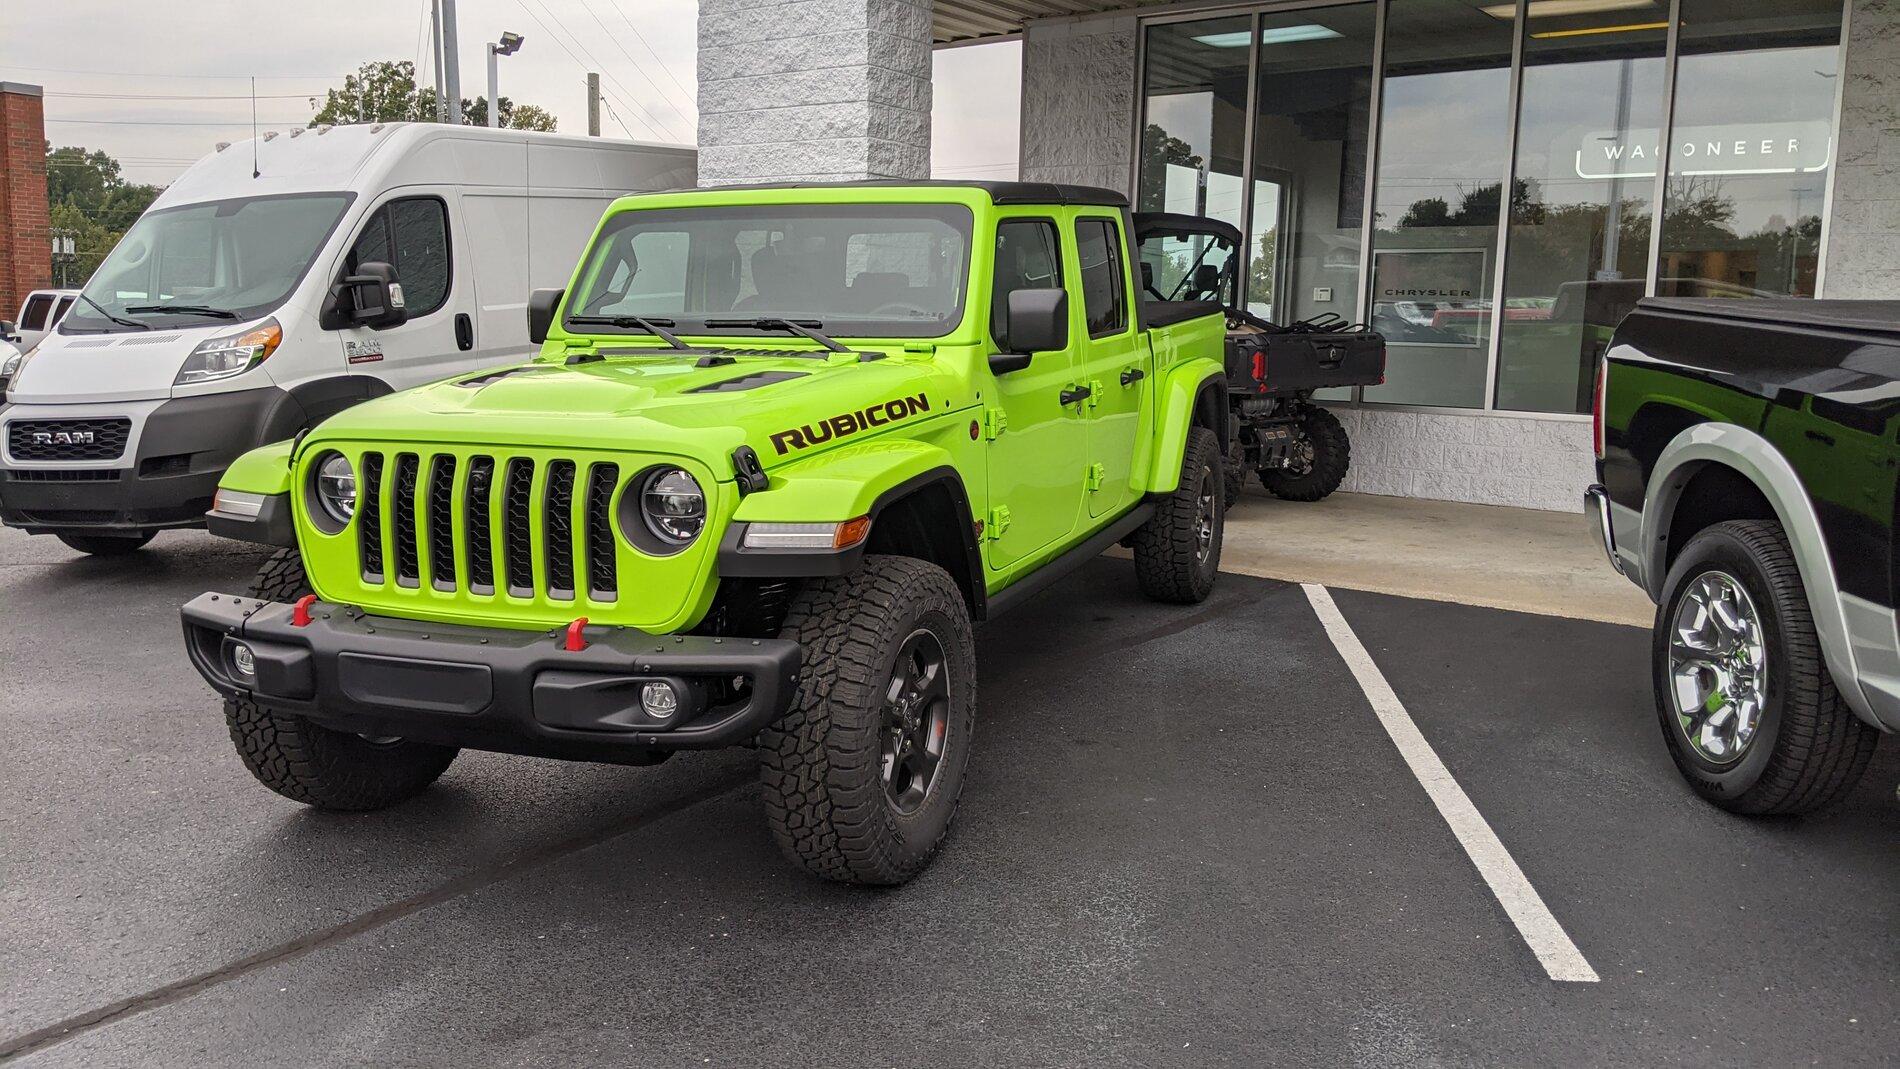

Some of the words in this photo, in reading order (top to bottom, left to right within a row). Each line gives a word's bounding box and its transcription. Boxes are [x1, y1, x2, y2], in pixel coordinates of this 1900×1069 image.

[1604, 138, 1800, 160] WAONEER
[1384, 288, 1472, 297] CHRYSLER
[769, 392, 931, 456] RUBICON
[32, 431, 95, 444] RAM
